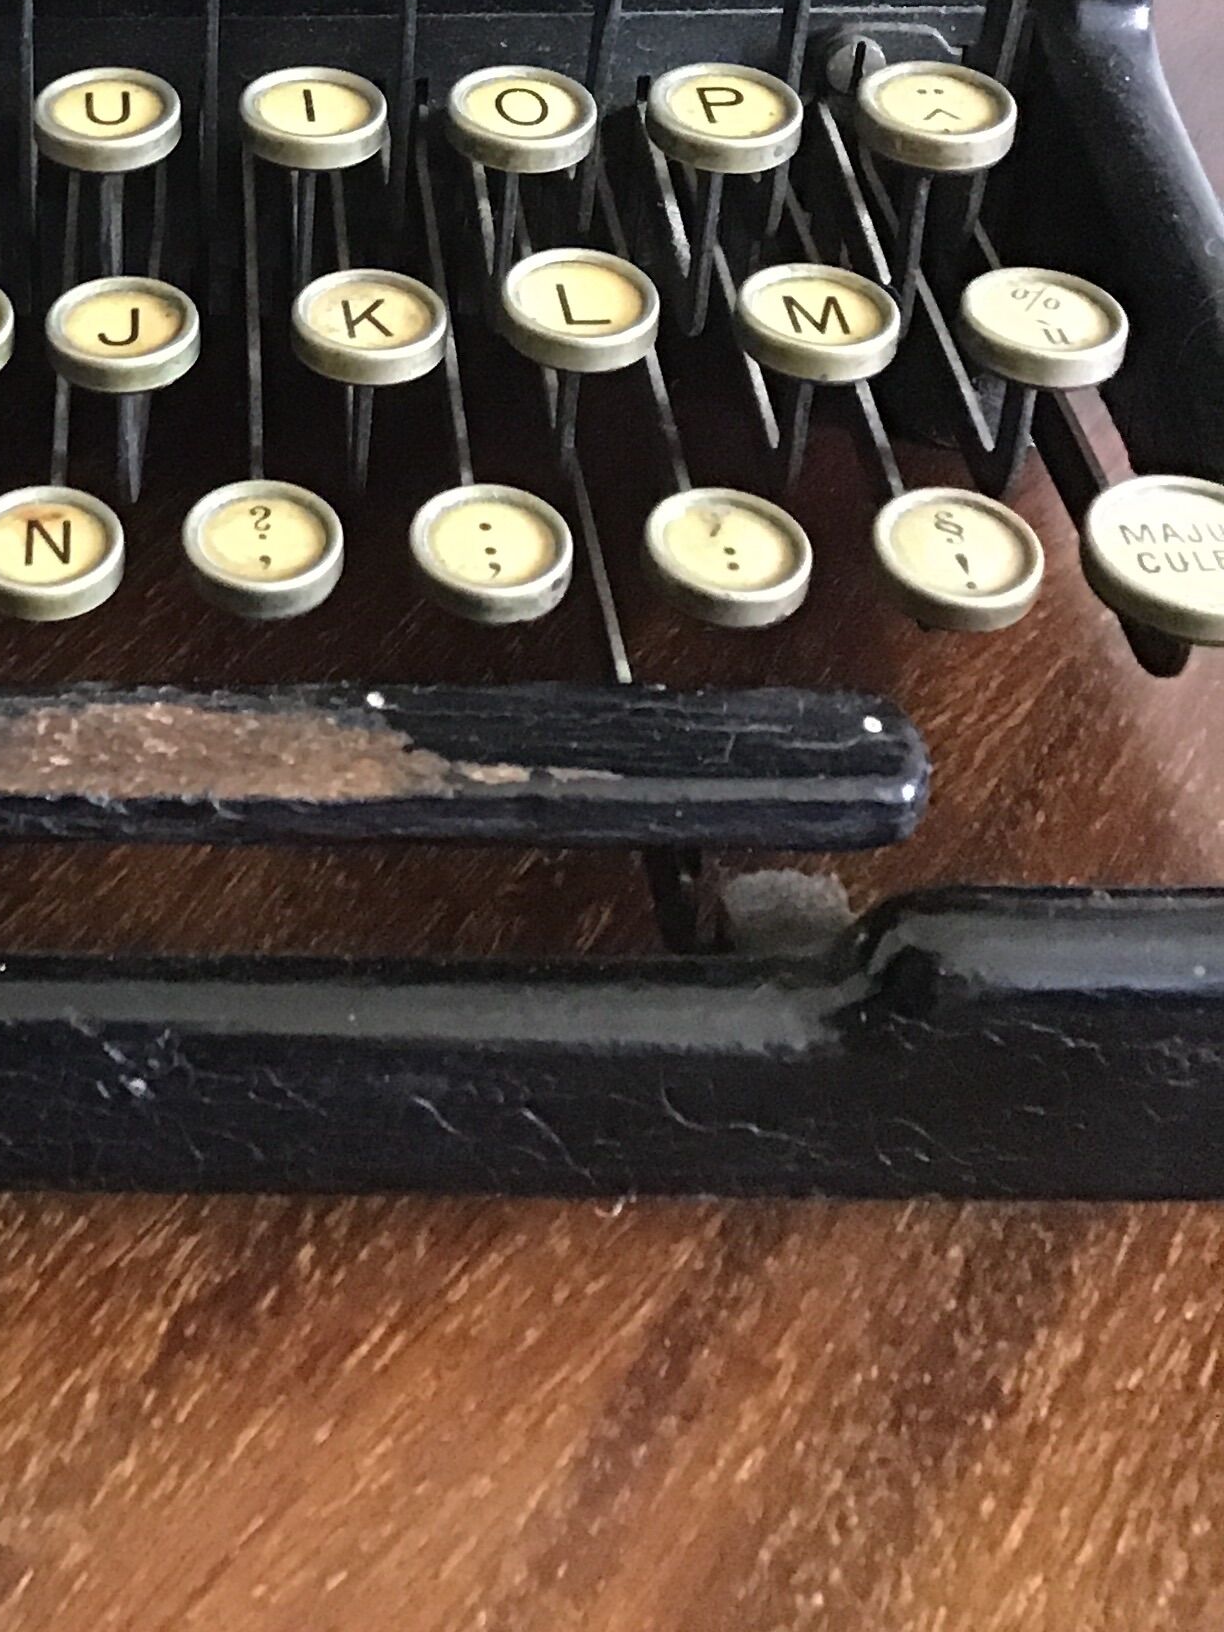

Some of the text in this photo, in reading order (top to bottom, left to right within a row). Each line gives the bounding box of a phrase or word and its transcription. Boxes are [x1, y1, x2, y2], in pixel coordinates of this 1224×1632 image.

[84, 91, 131, 125] U
[303, 88, 316, 123] I
[495, 88, 549, 126] O
[696, 87, 745, 124] P
[341, 299, 394, 339] K
[556, 283, 612, 326] L
[782, 295, 851, 335] M
[98, 307, 140, 346] J
[249, 505, 271, 540] ?
[24, 519, 72, 566] N
[954, 553, 977, 590] !
